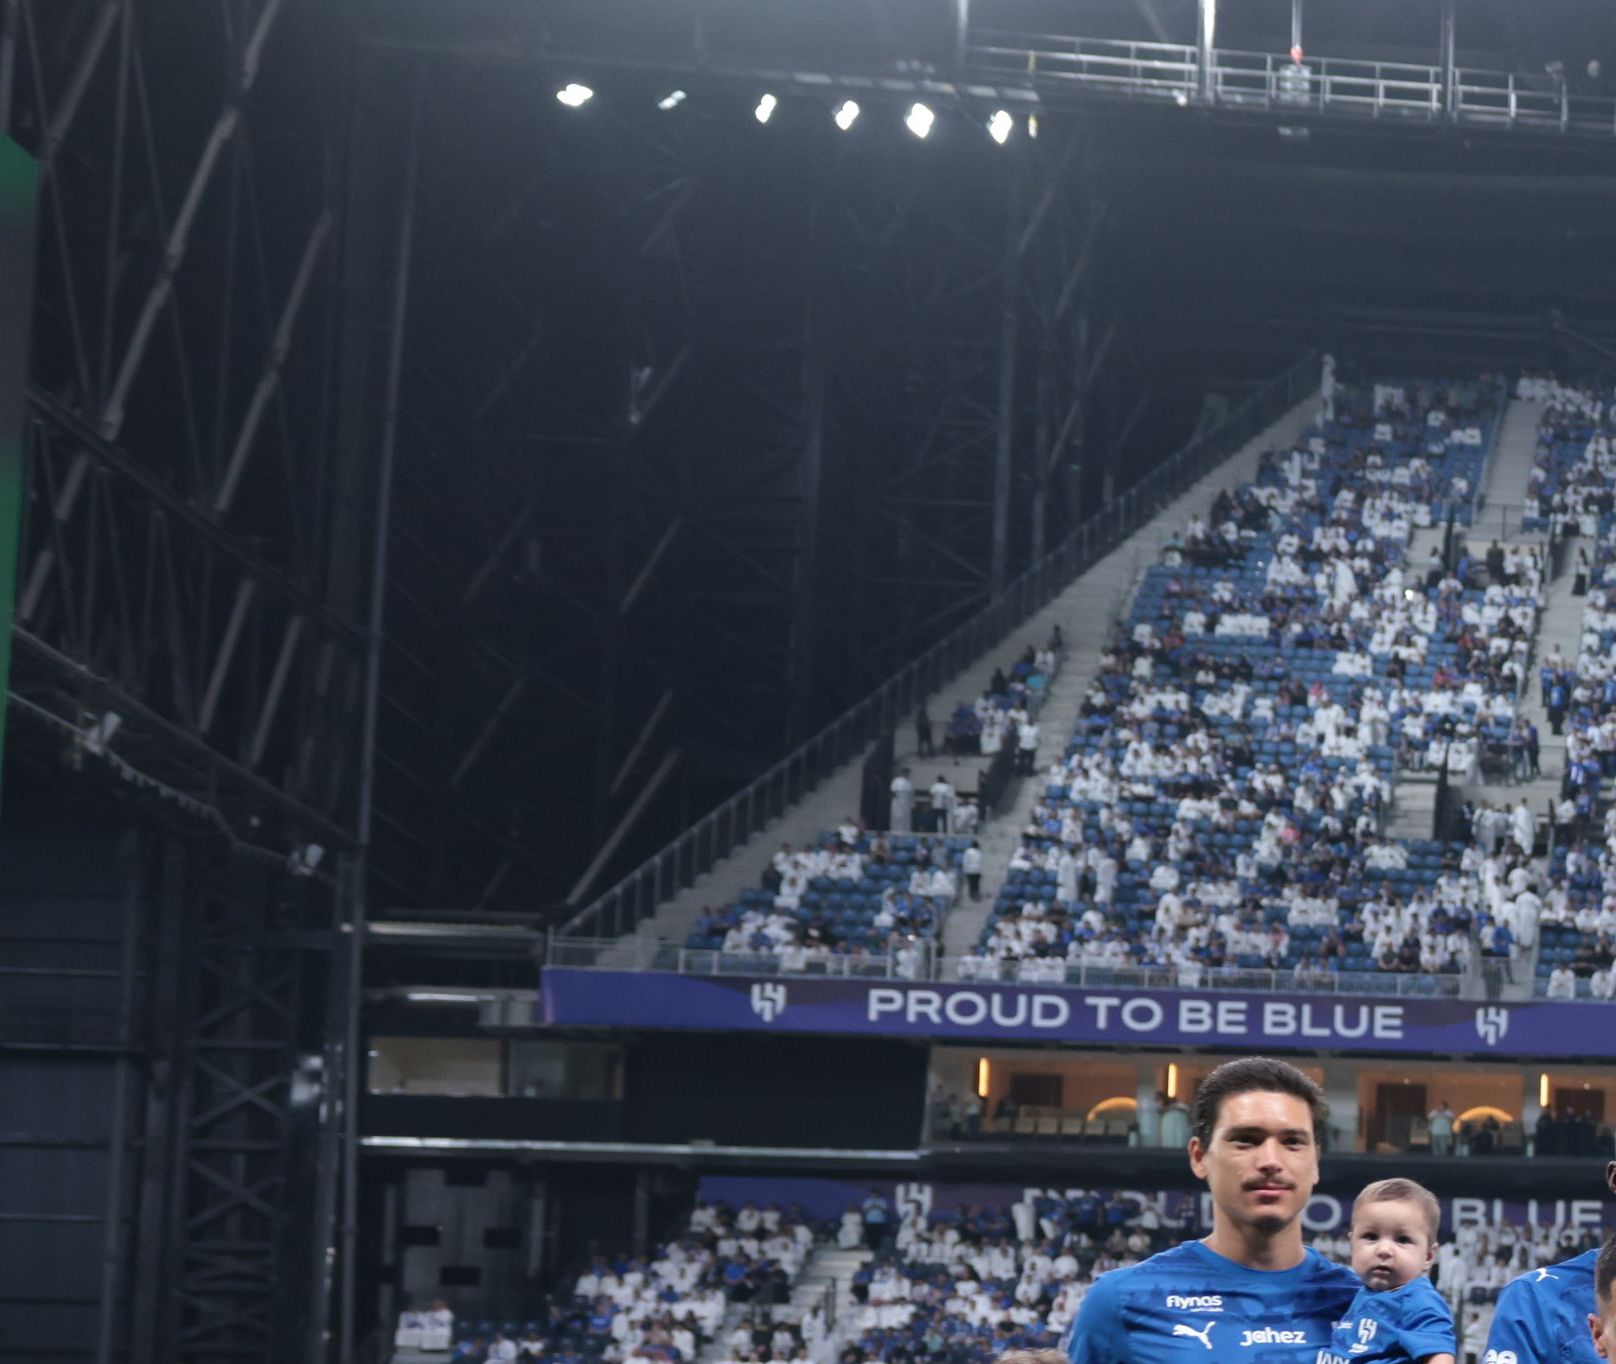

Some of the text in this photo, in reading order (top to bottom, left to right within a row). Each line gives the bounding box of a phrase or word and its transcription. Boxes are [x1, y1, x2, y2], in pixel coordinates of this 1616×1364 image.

[867, 988, 1404, 1039] PROUD TO BE BLUE
[1165, 1294, 1222, 1309] flynas
